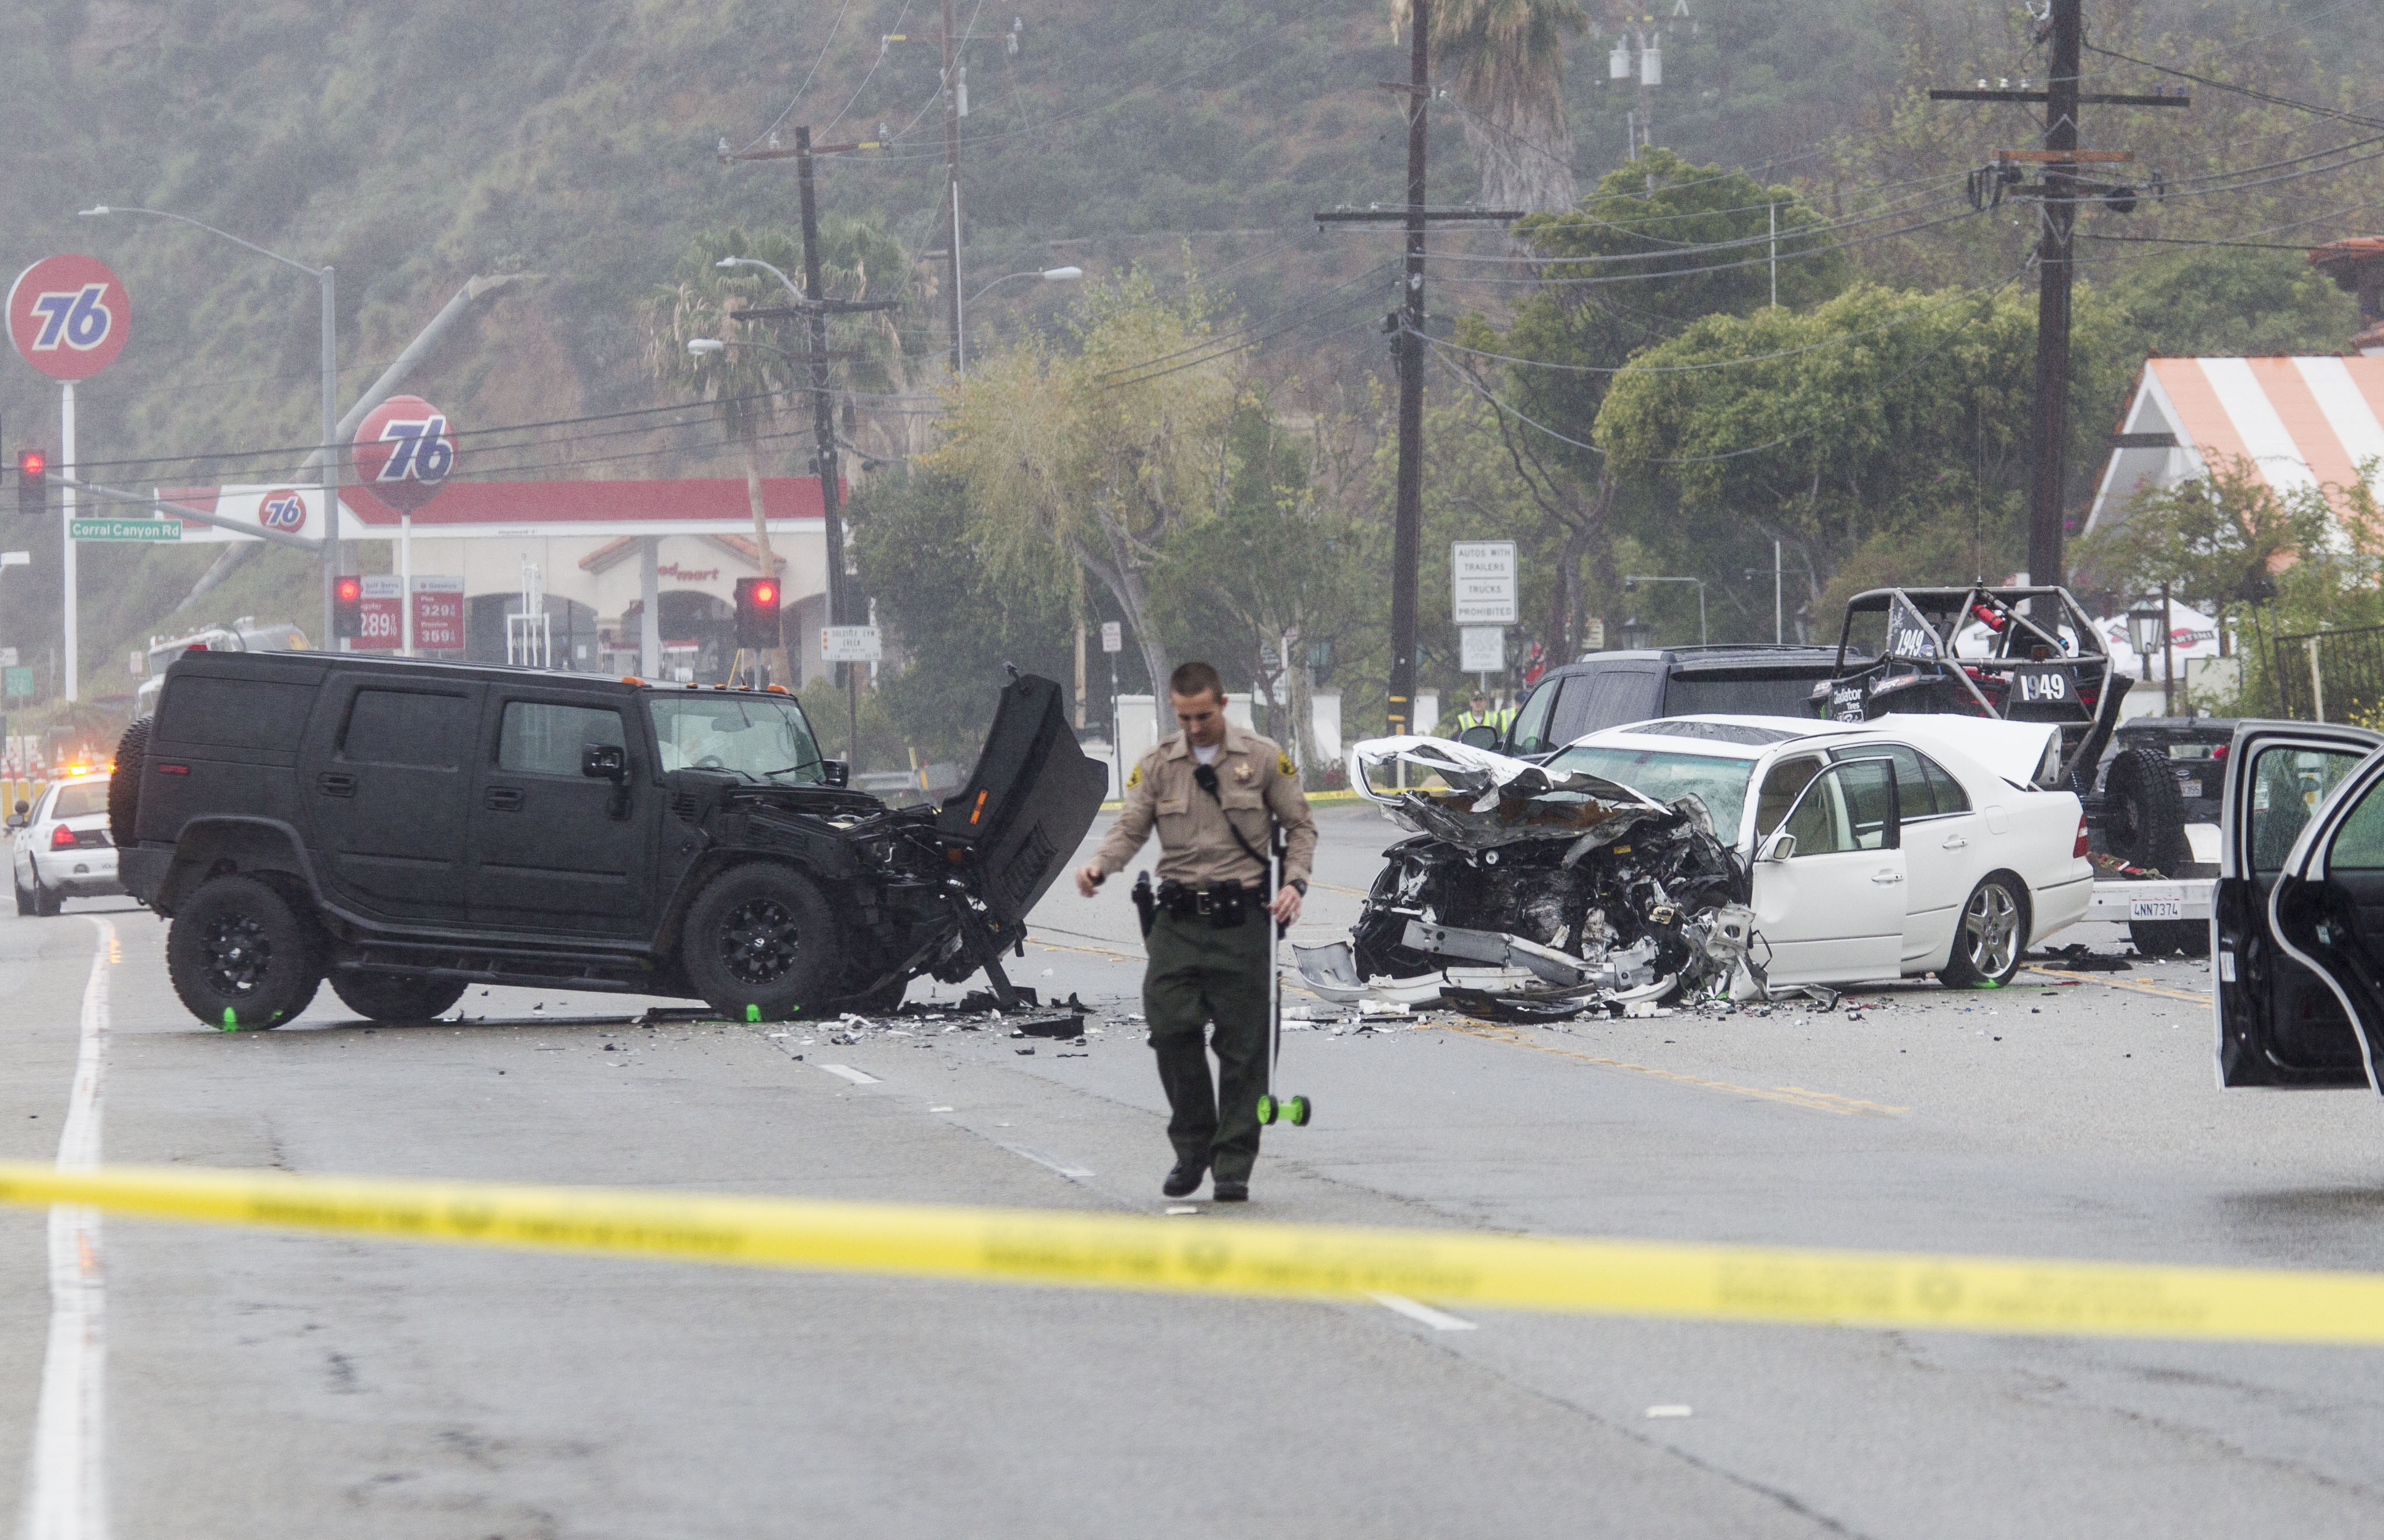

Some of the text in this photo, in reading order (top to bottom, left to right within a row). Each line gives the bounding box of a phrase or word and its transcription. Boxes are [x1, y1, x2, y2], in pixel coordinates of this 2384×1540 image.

[30, 283, 112, 351] 76
[376, 414, 454, 484] 76
[265, 496, 301, 526] 76
[73, 524, 179, 539] Corral Canyon Rd
[1458, 548, 1485, 557] AUTOS
[1464, 562, 1505, 571] TRAILERS
[1469, 585, 1501, 594] TRUCKS
[421, 604, 450, 616] 329
[1459, 608, 1512, 616] PROHIBITED
[361, 613, 390, 637] 289
[1895, 629, 1925, 657] 1949
[2171, 631, 2214, 644] ARTINI
[2020, 673, 2065, 701] 1949
[1846, 702, 1860, 710] Tires
[2134, 903, 2178, 917] 4NN7374
